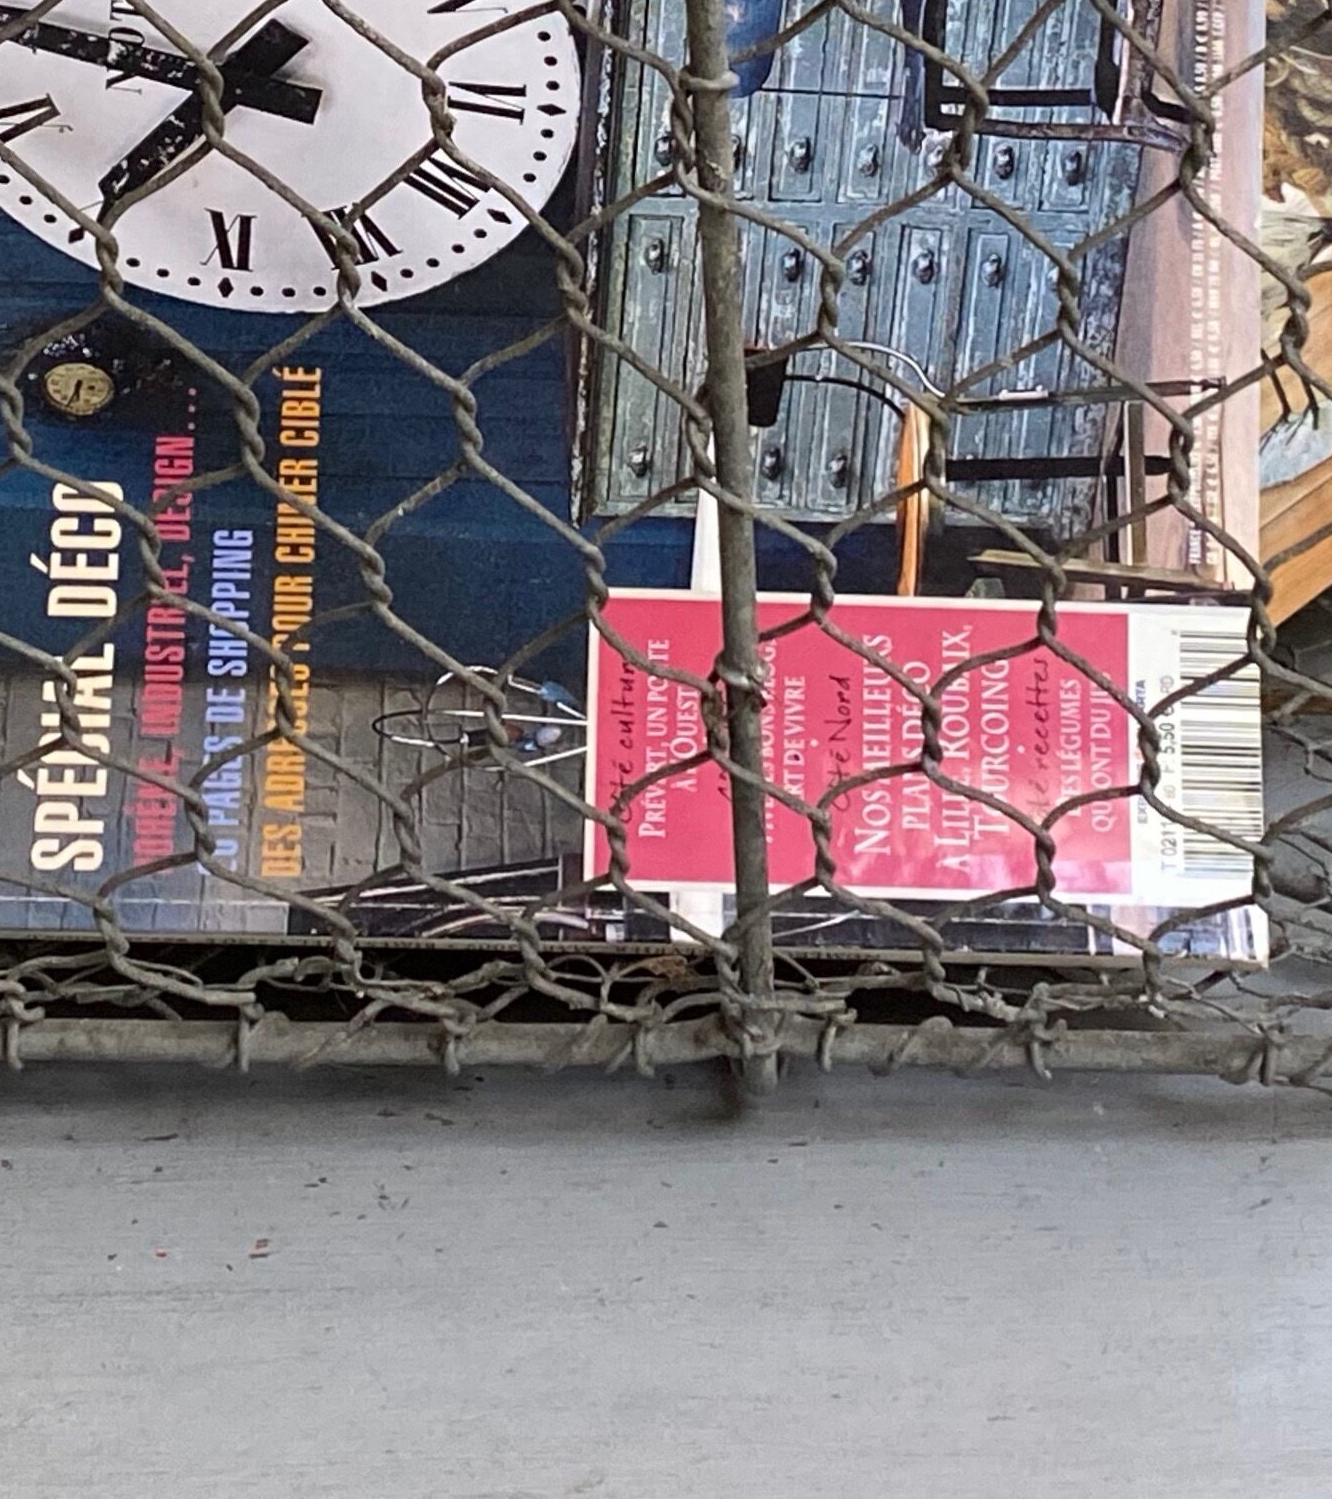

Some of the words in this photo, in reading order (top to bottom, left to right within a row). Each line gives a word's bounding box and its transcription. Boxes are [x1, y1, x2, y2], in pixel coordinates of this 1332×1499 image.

[272, 365, 322, 447] CIBLÉ
[28, 480, 125, 617] DÉCO
[136, 554, 195, 736] INDUSTREL,
[646, 638, 670, 702] POTE
[205, 687, 247, 723] DE
[610, 658, 635, 749] cultur
[646, 706, 668, 737] UN
[783, 675, 806, 736] VIVRE
[823, 675, 852, 742] Nord
[1055, 679, 1082, 771] LÉGUMES
[1090, 709, 1111, 739] DU
[16, 642, 115, 873] SPÉCIAL
[783, 739, 805, 766] DE
[1090, 741, 1112, 789] ONT
[260, 823, 303, 877] DES
[853, 789, 892, 855] NOS
